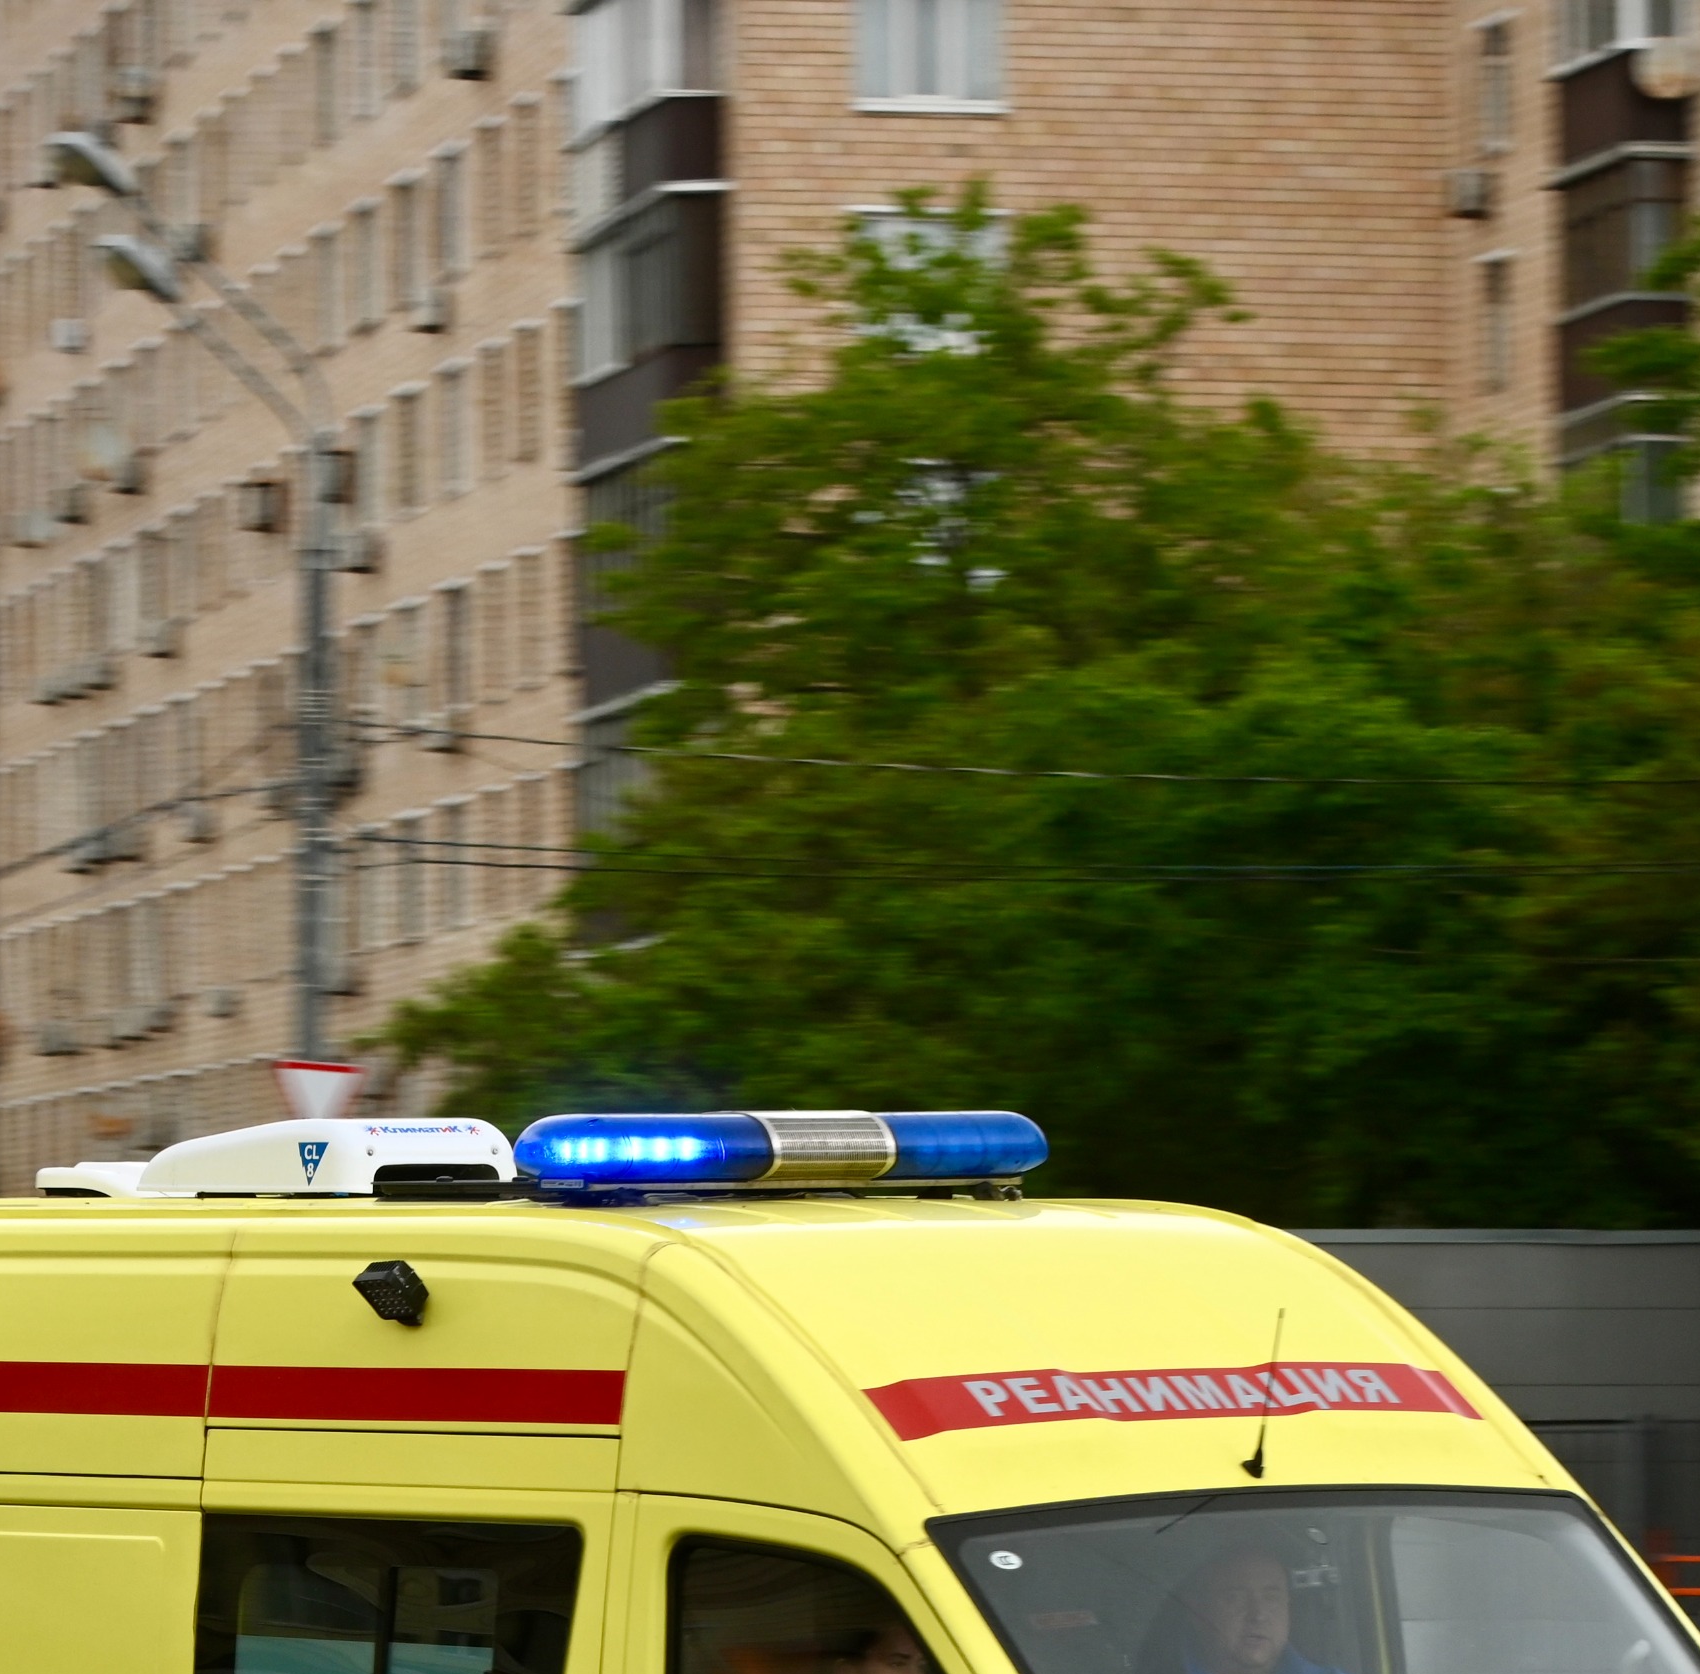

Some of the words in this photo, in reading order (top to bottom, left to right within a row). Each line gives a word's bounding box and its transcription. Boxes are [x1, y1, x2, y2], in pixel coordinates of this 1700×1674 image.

[304, 1145, 320, 1160] CL
[306, 1162, 315, 1178] 8
[963, 1367, 1401, 1417] РЕАНИМАЦИЯ
